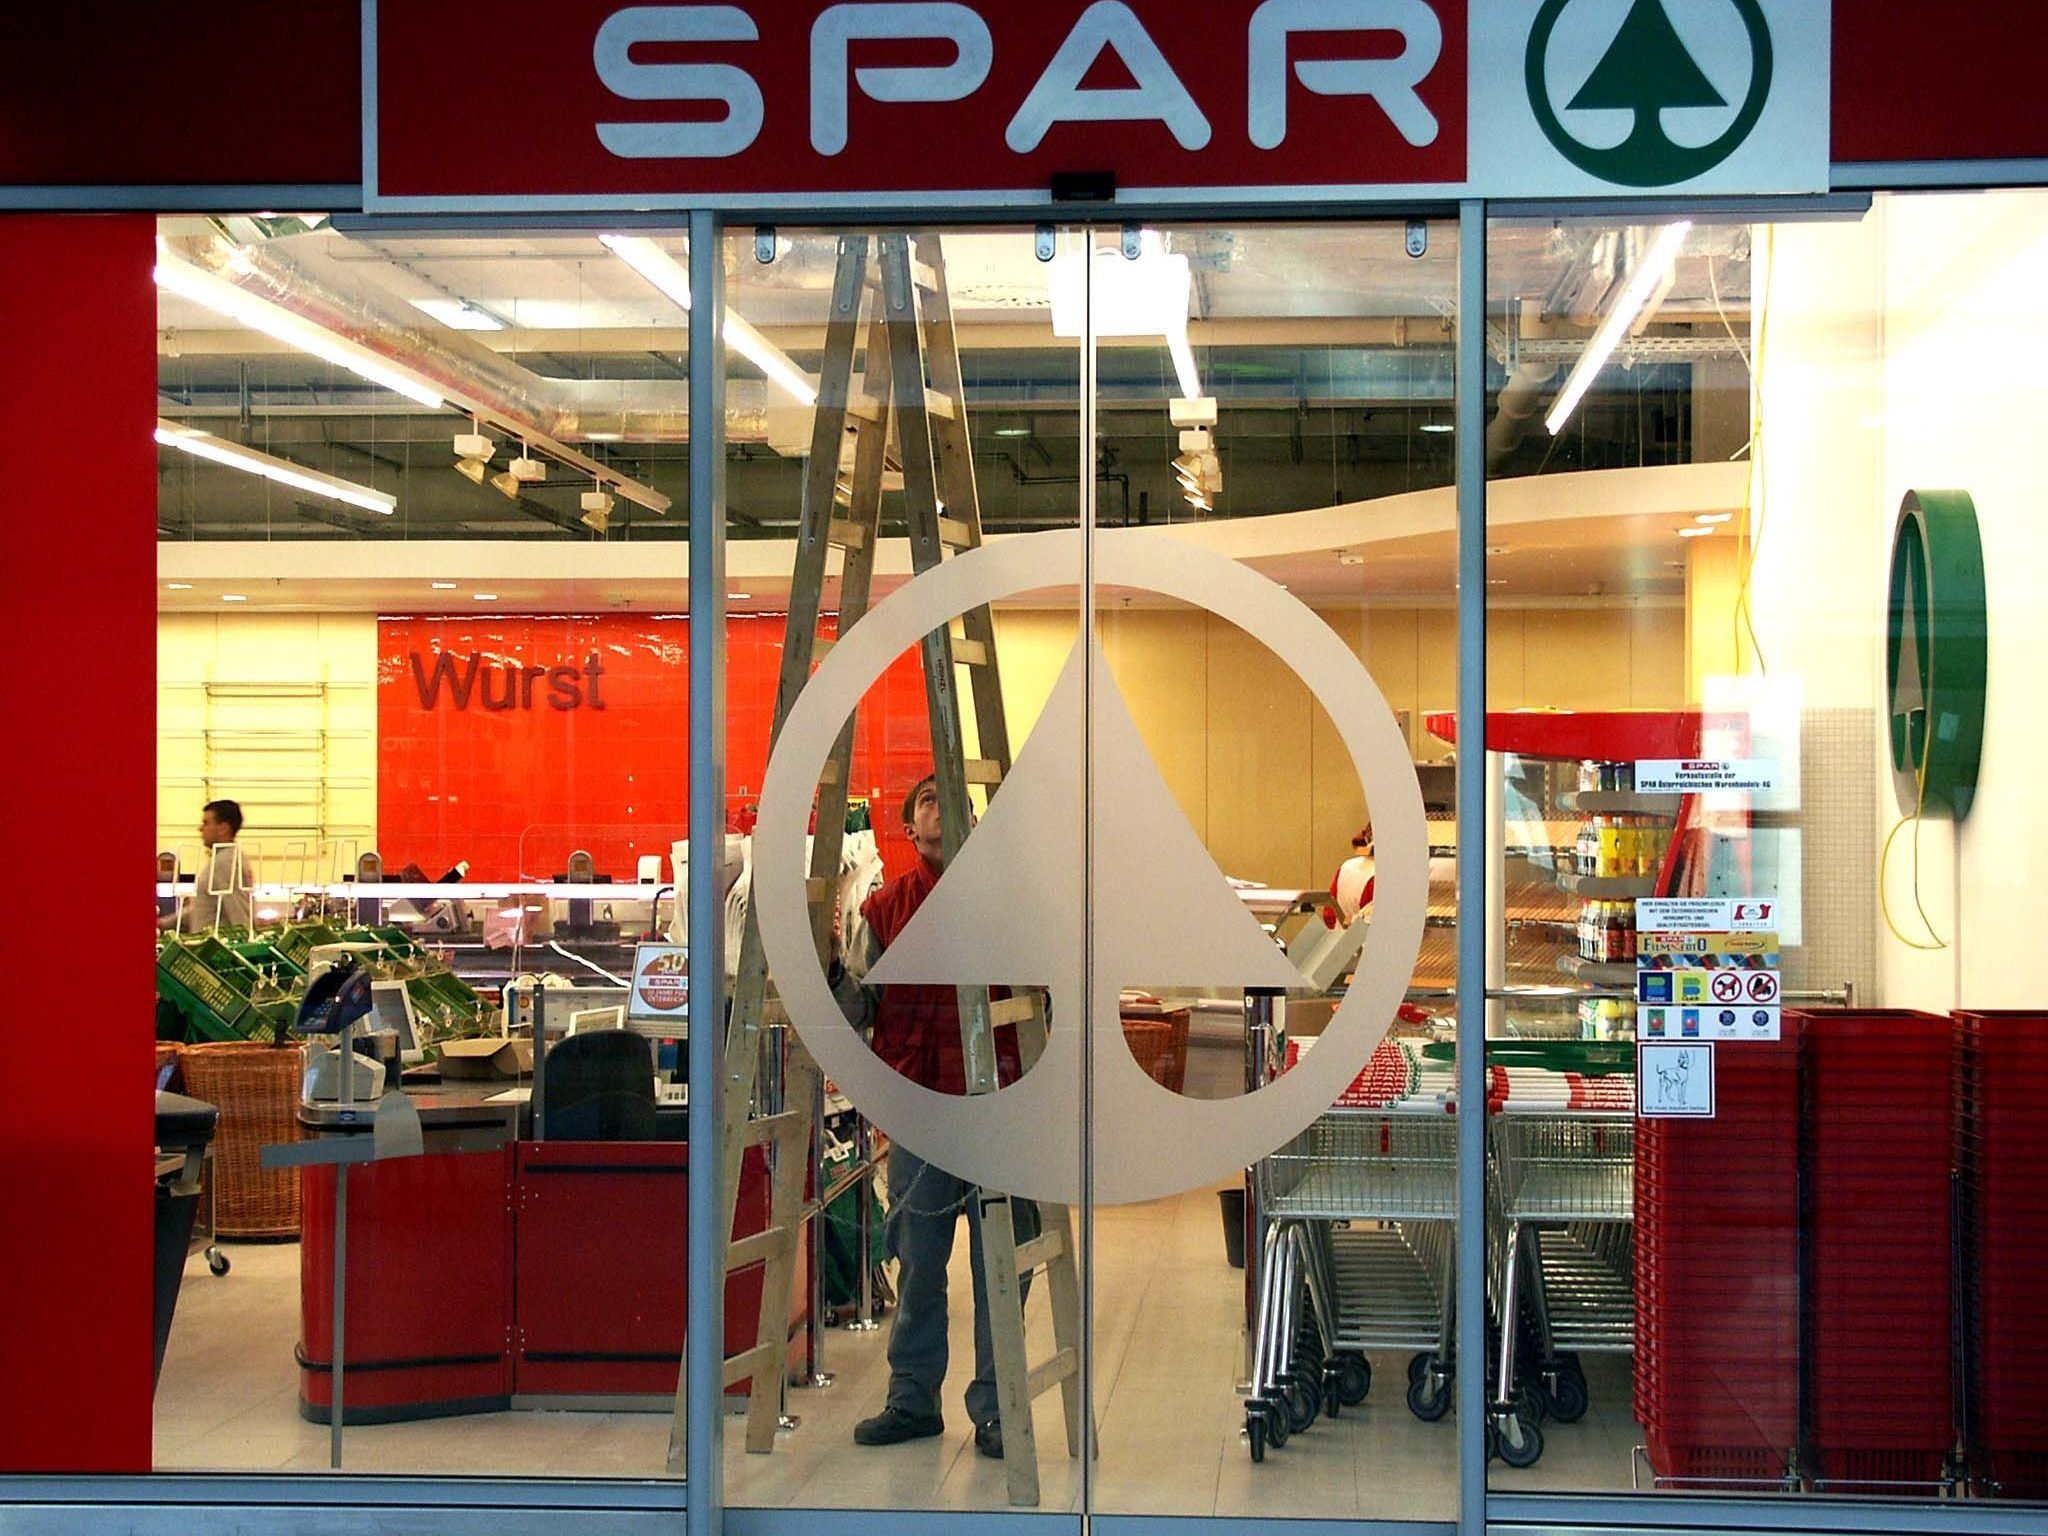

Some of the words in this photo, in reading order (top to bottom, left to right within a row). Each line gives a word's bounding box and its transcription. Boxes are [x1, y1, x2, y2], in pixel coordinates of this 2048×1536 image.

[594, 0, 1443, 158] SPAR
[409, 652, 606, 711] Wurst
[1687, 762, 1719, 770] SPAR
[1641, 780, 1657, 788] SPAR
[656, 953, 685, 972] 50
